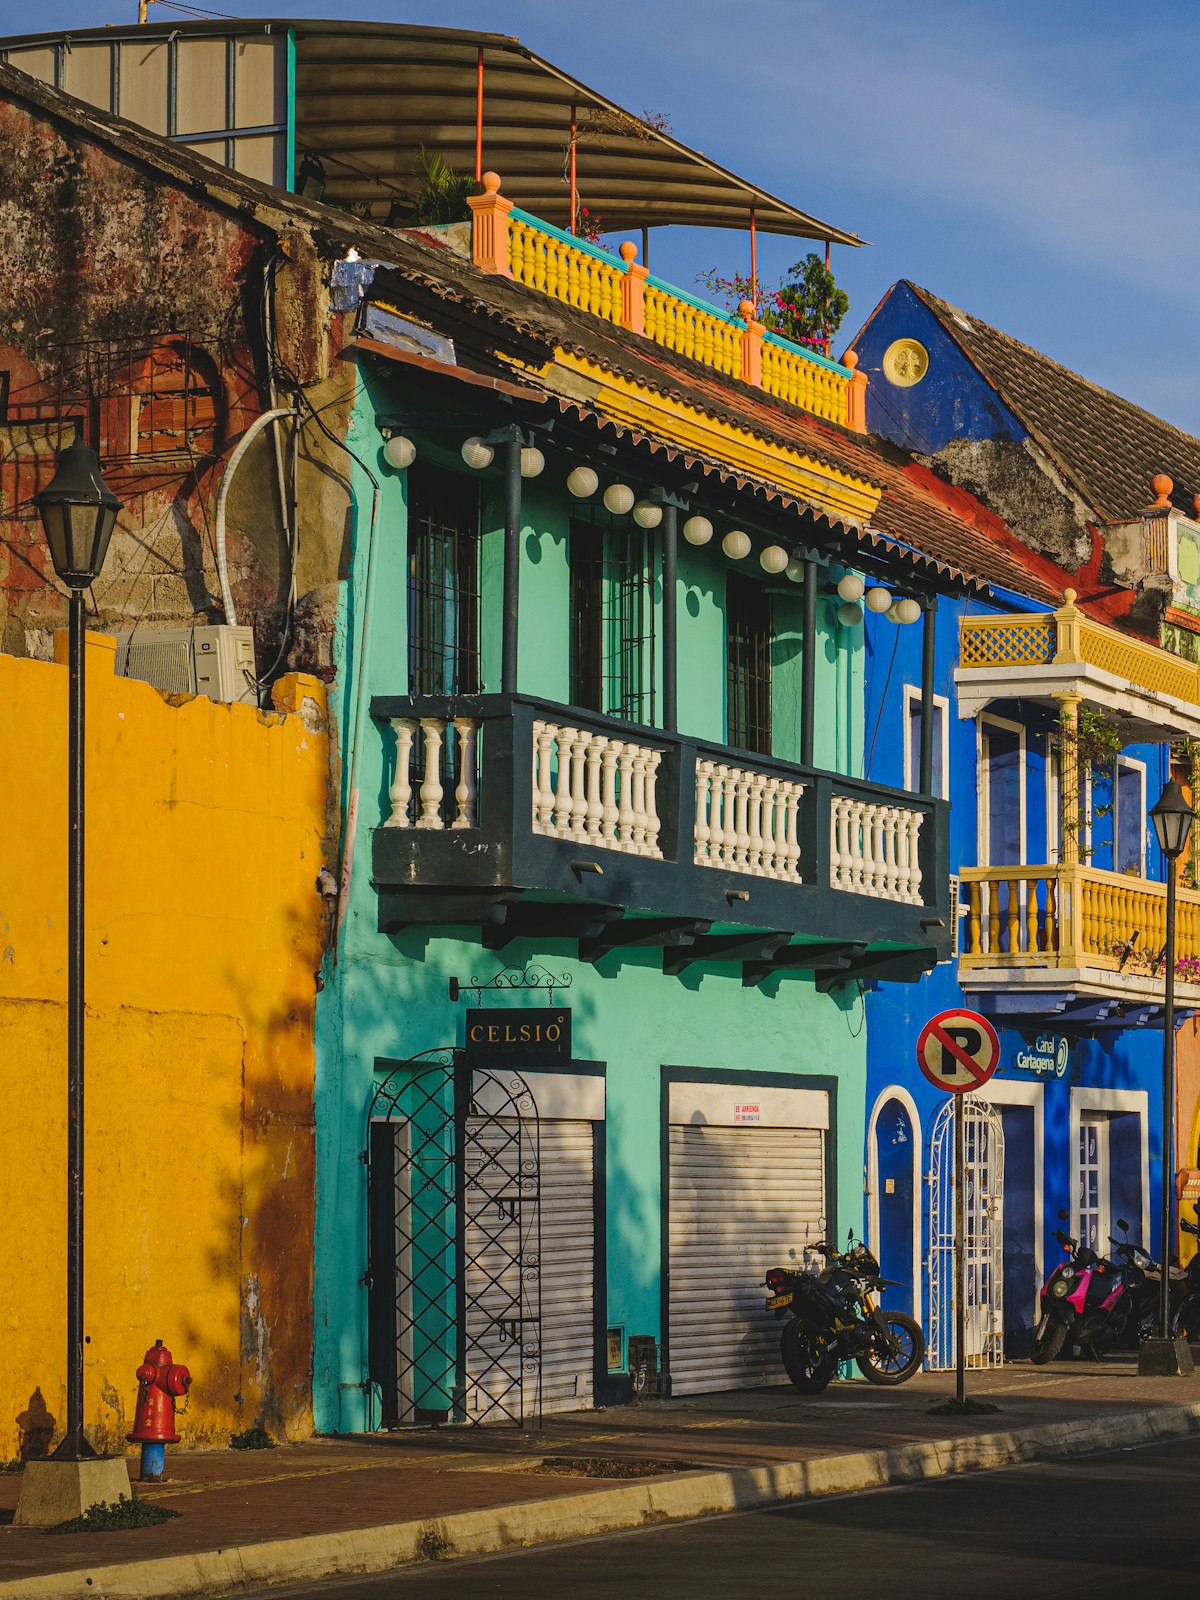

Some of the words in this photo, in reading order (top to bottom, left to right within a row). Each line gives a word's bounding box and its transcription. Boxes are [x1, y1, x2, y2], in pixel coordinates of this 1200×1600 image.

[941, 1027, 982, 1075] P
[1035, 1036, 1055, 1054] Canal
[1017, 1051, 1055, 1074] Cartagena
